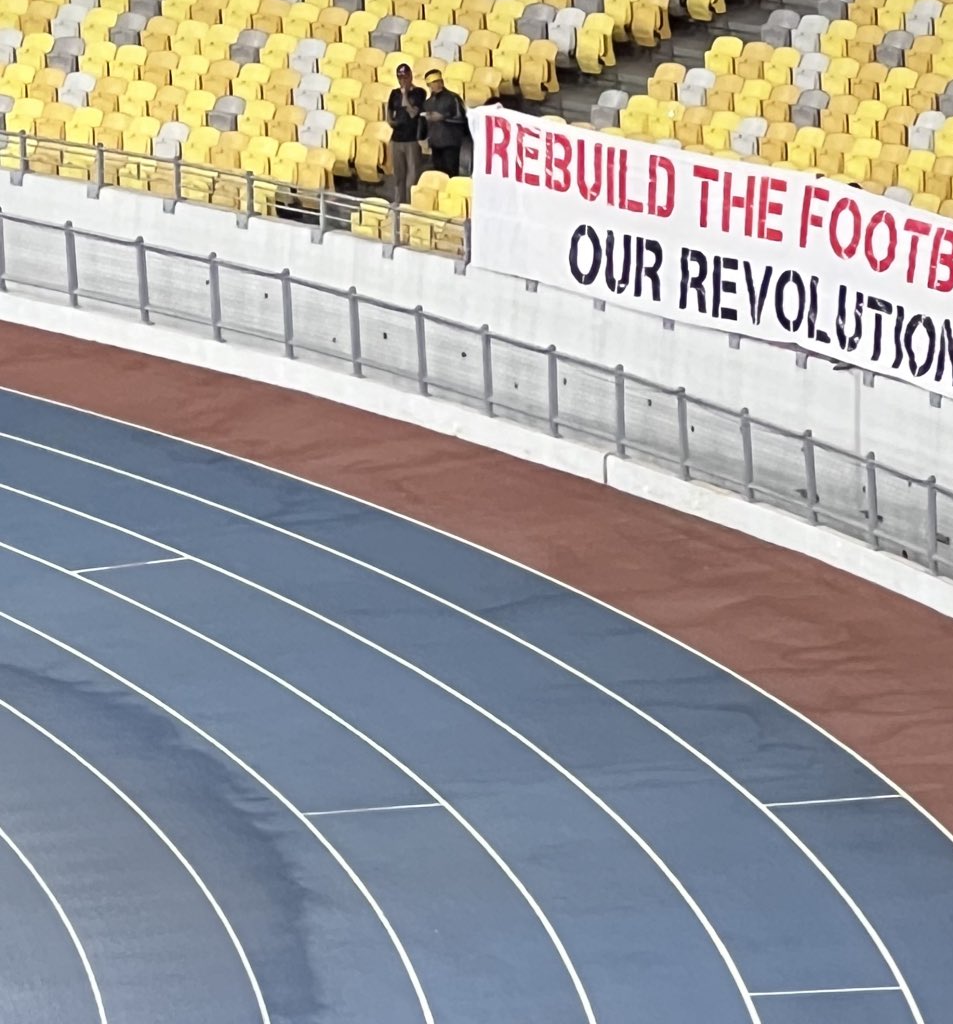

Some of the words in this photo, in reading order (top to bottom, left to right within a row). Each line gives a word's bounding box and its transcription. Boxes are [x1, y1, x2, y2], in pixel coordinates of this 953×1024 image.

[484, 114, 676, 218] REBUILD
[692, 165, 788, 243] THE
[567, 223, 664, 301] OUR
